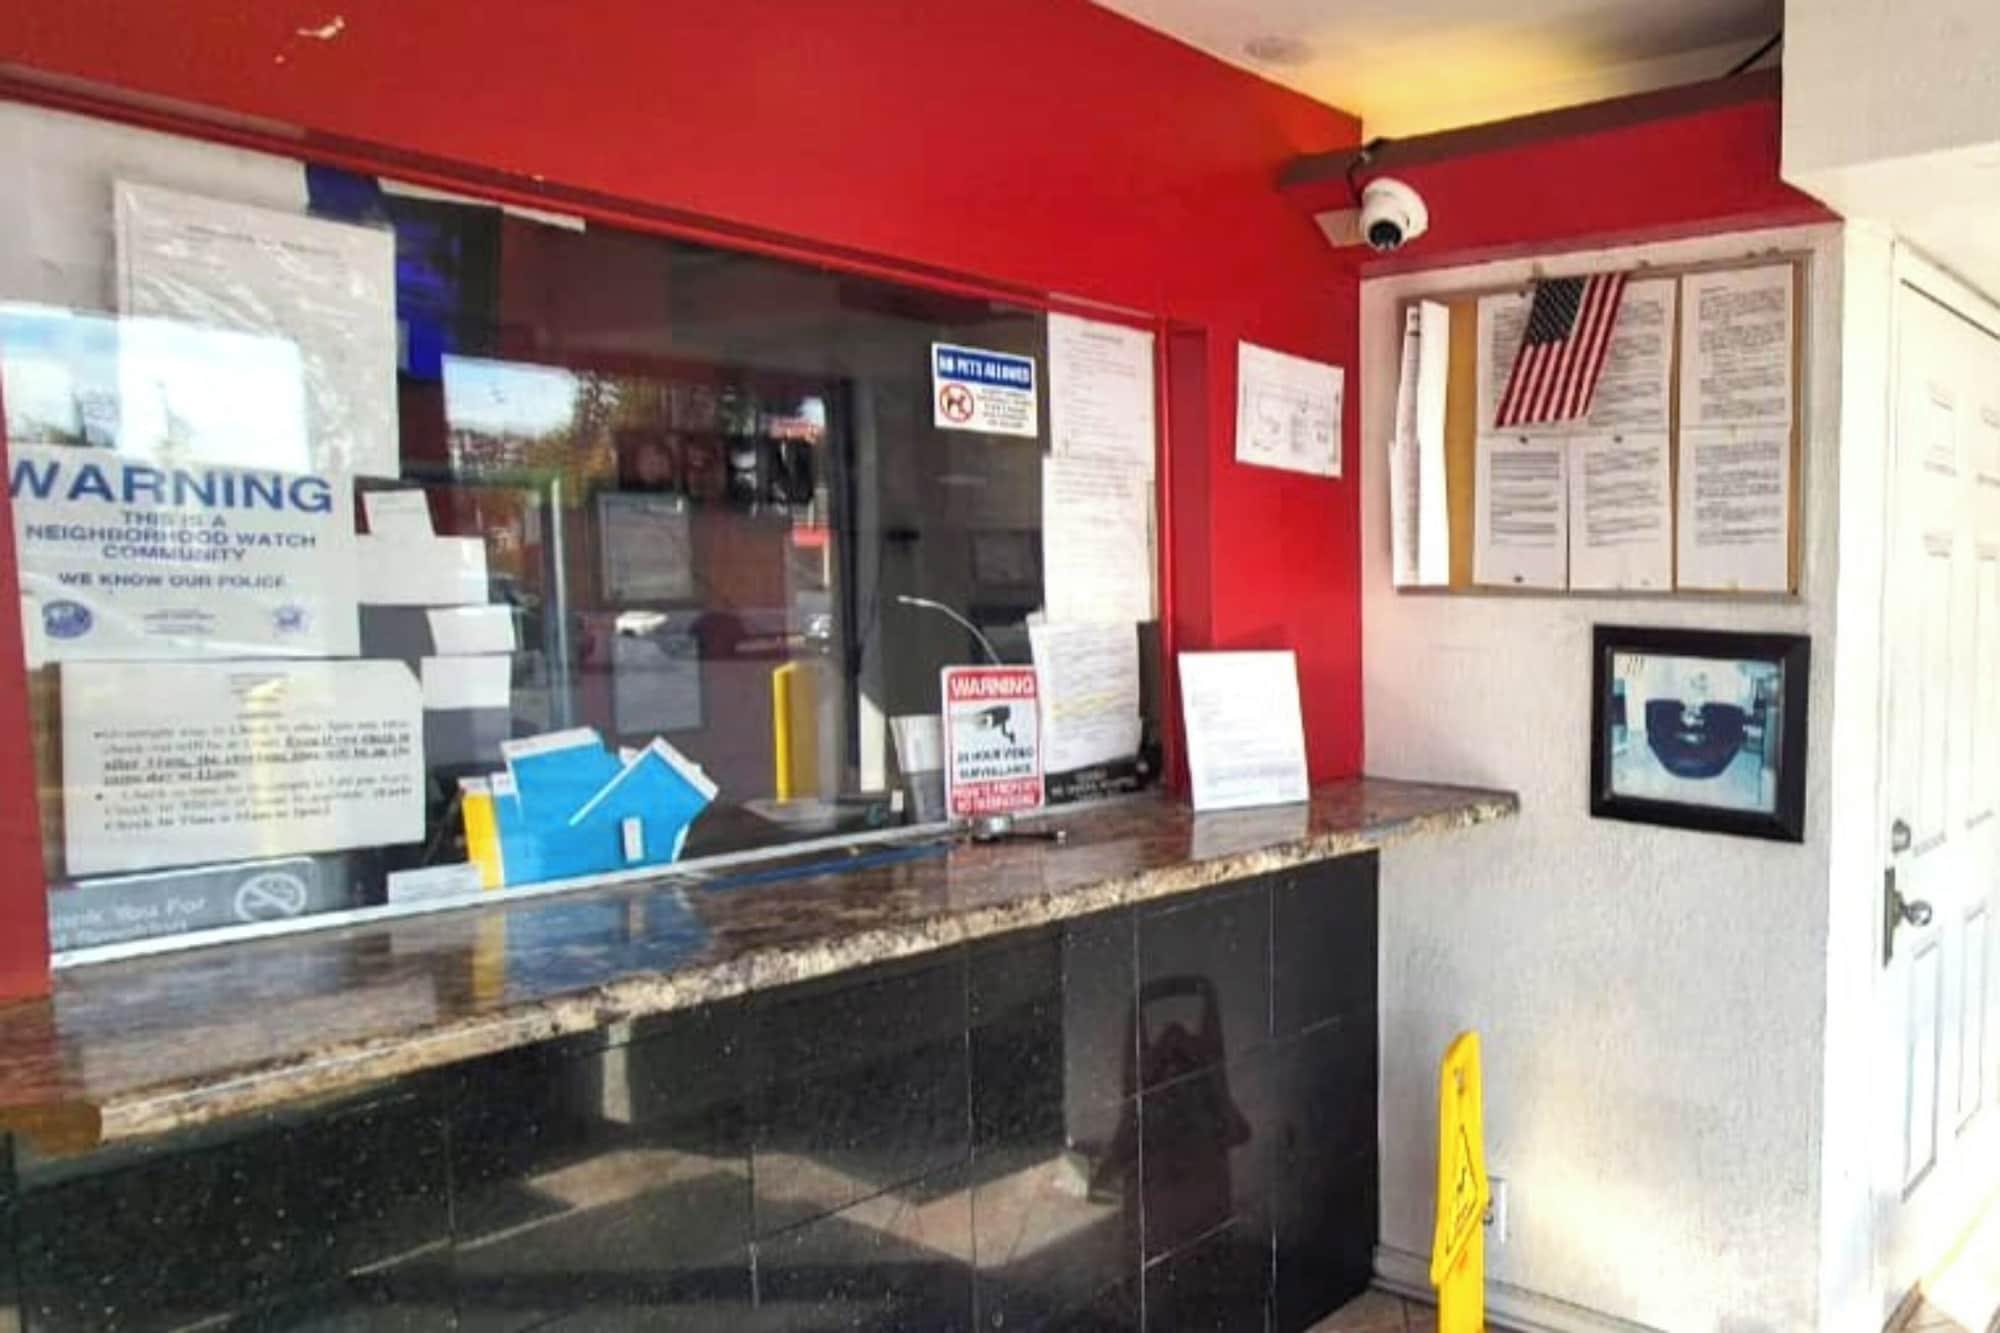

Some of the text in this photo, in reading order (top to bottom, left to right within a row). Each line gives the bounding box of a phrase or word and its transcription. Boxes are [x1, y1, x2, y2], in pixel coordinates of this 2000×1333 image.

[8, 459, 333, 514] WARNING
[121, 511, 174, 526] THIS
[211, 514, 227, 528] A
[25, 524, 317, 548] NEIGHBORHOOD WATCH
[102, 541, 248, 562] COMMUNITY
[58, 571, 286, 589] WE KNOW OUR POLICE
[951, 676, 1034, 697] WARNING
